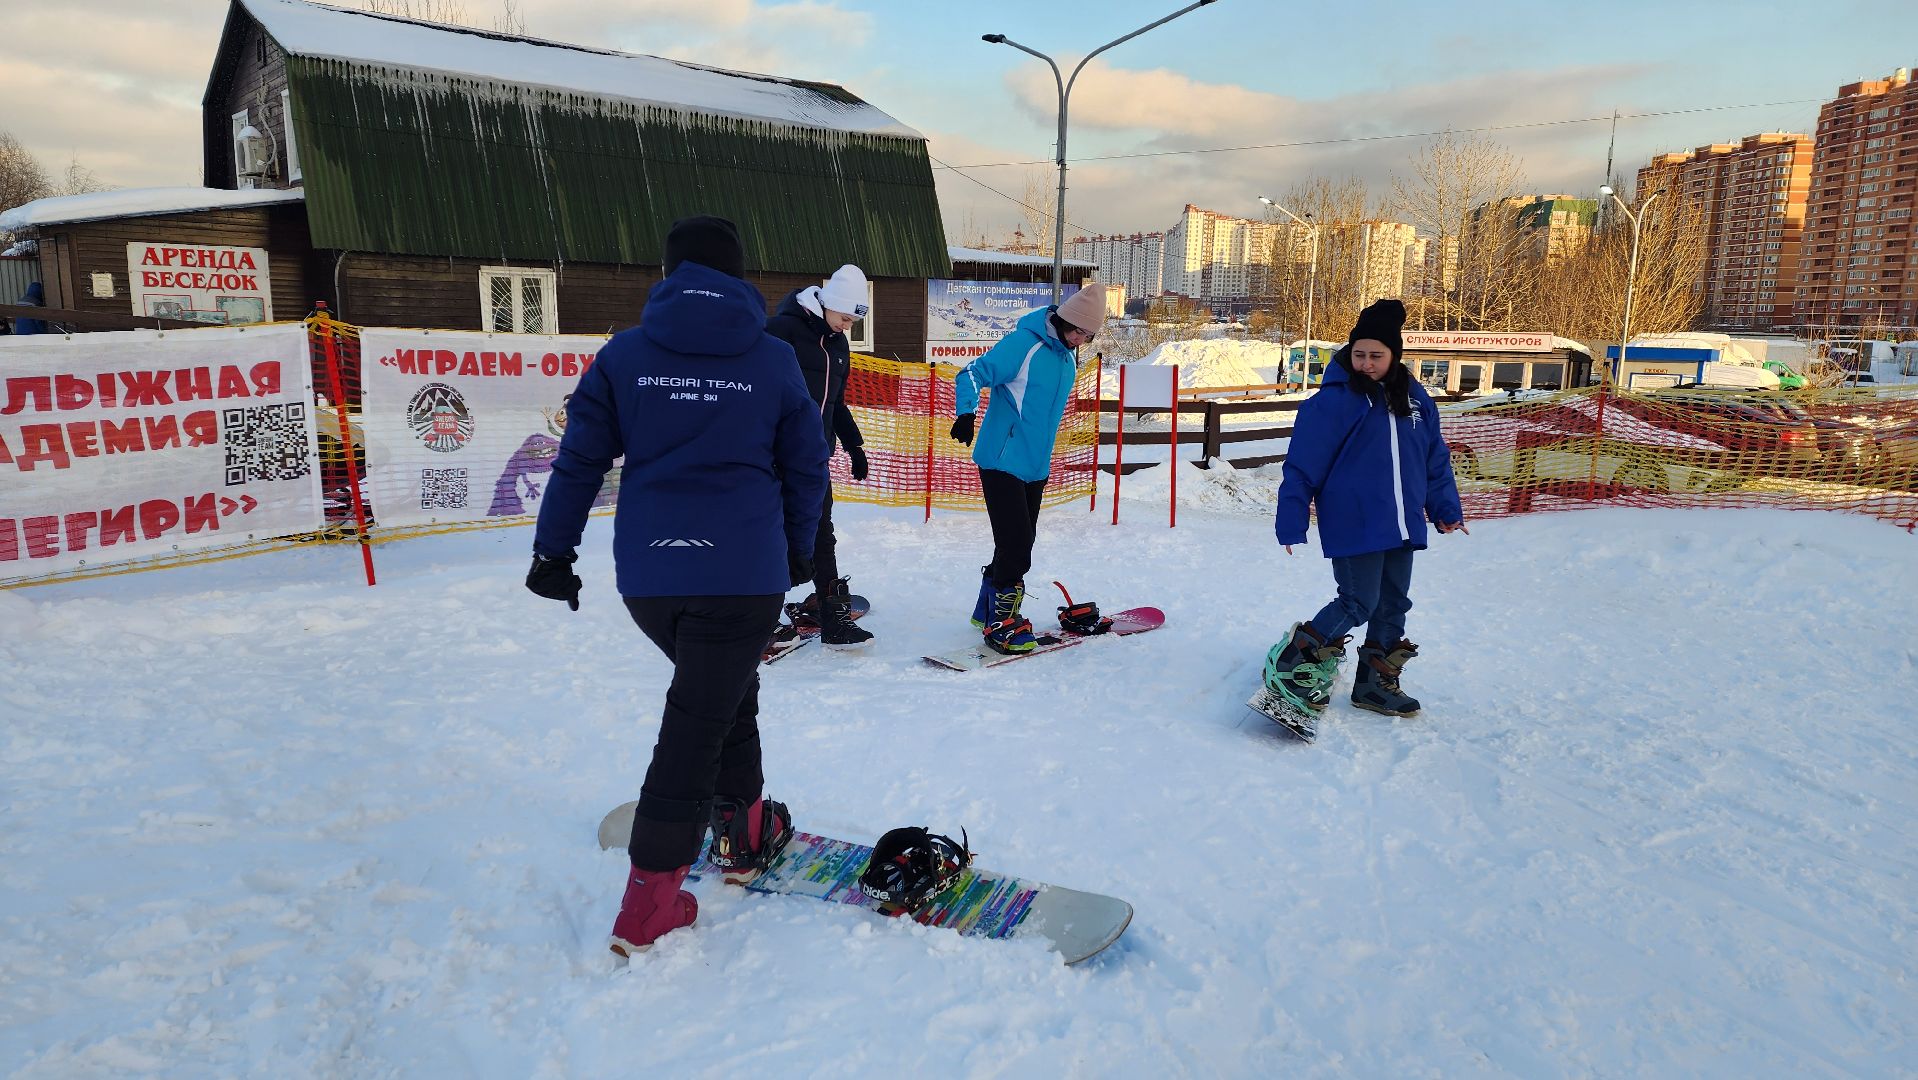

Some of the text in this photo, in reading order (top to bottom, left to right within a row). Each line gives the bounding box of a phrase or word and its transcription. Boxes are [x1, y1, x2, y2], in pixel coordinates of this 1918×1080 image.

[141, 247, 257, 273] АРЕНДА
[142, 271, 259, 293] БЕСЕДОК
[946, 283, 981, 294] Детская
[984, 297, 1028, 308] Фристайл
[1406, 335, 1542, 346] СЛУЖБА ИНСТРУКТОРОВ
[0, 361, 281, 415] ЛЫЖНАЯ
[637, 376, 752, 393] SNEGIRI TEAM
[669, 392, 718, 401] ALPINE SKI
